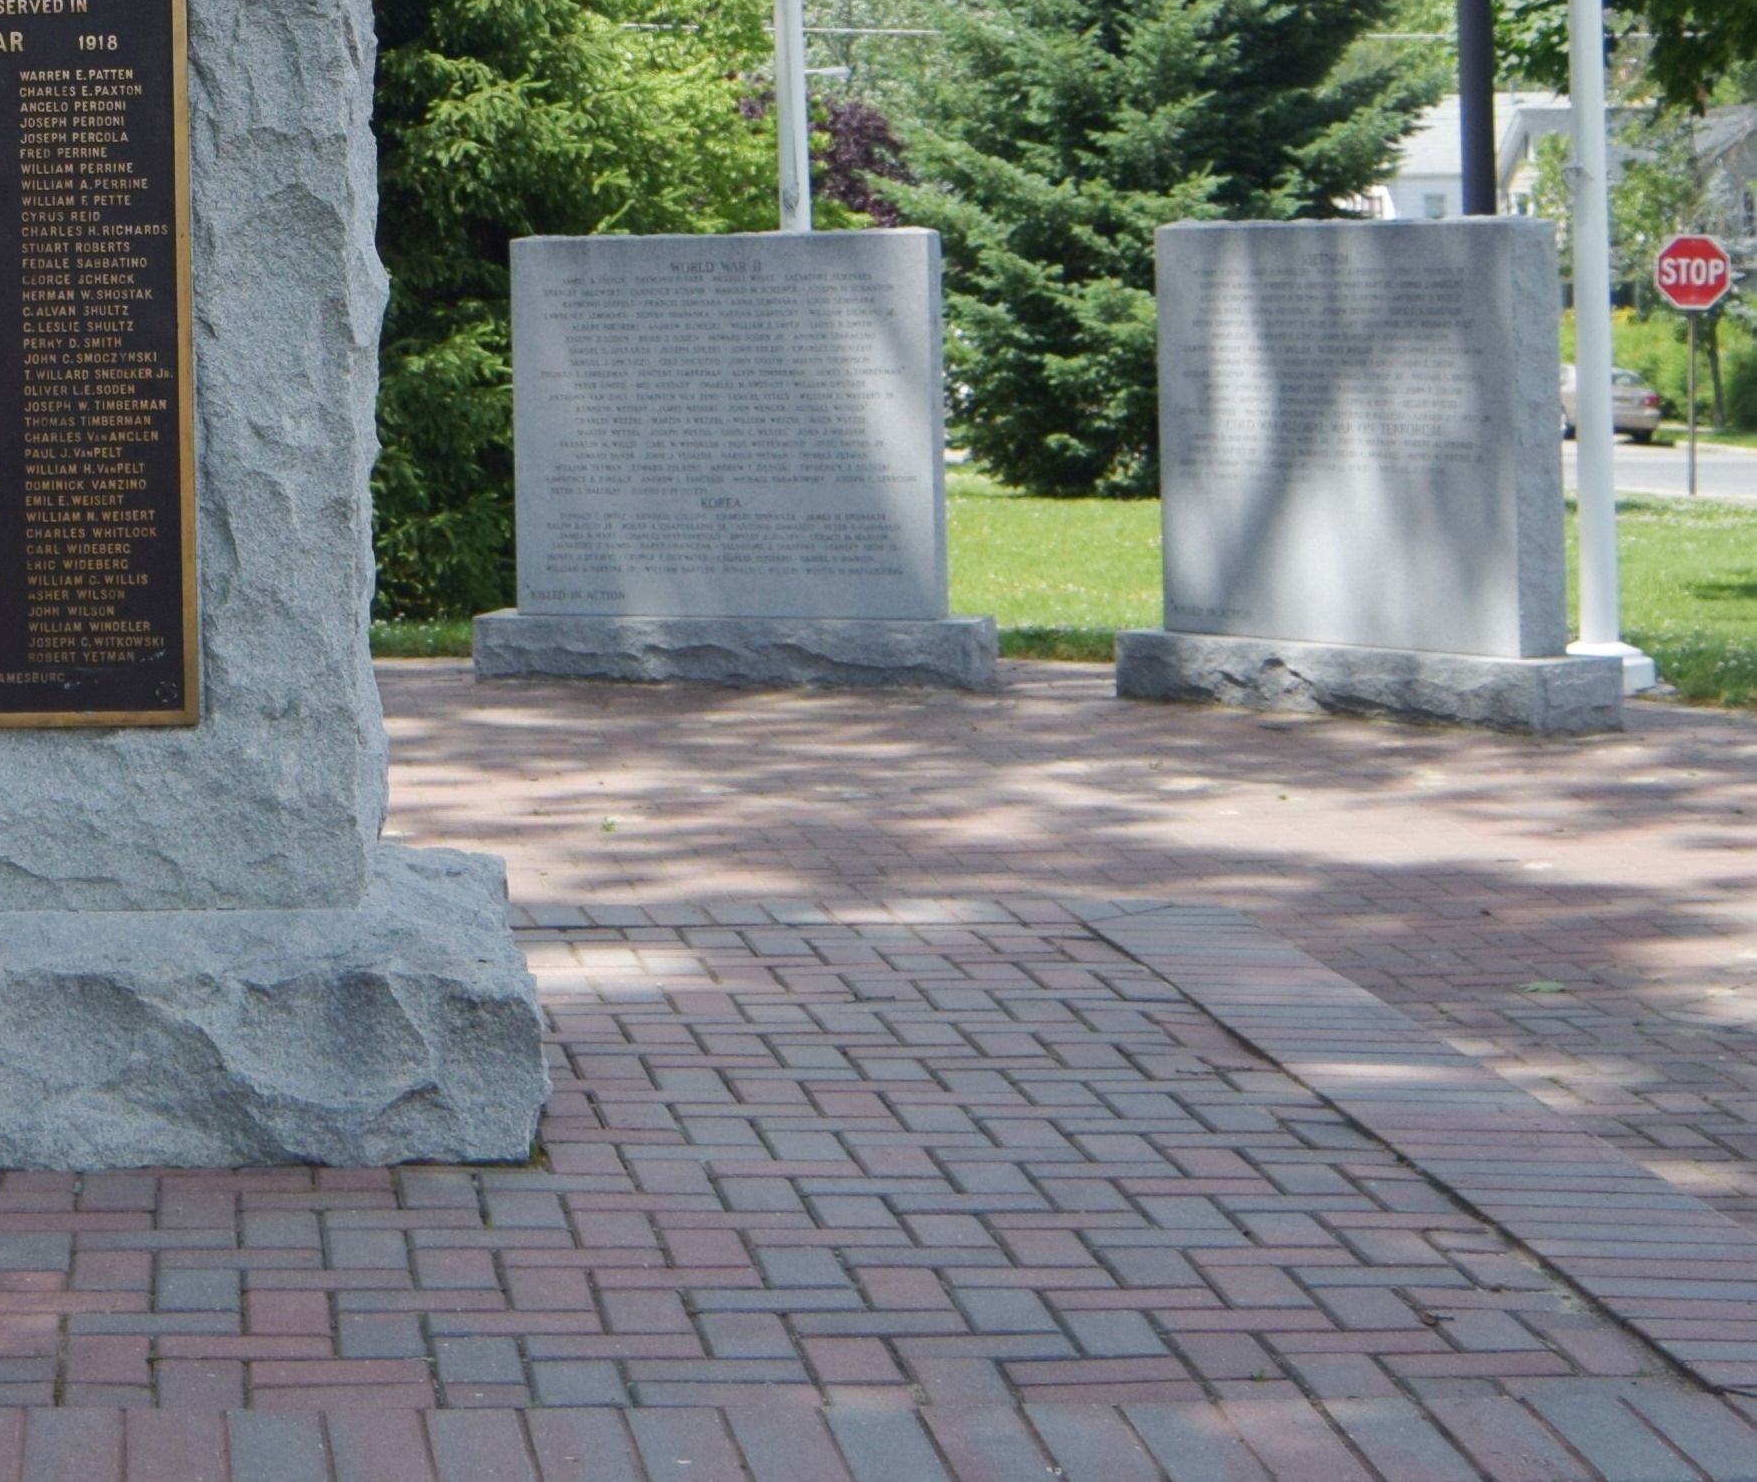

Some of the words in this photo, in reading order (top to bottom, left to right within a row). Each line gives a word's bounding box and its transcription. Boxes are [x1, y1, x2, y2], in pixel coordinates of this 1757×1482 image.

[78, 35, 118, 51] 1918
[74, 100, 126, 112] PERDONI
[20, 116, 67, 128] JOSEPH
[73, 115, 124, 127] PERDONI
[20, 147, 50, 159] FRED
[57, 146, 107, 158] PERRINE
[21, 163, 73, 175] WILLIAM
[80, 162, 133, 174] PERRINE
[21, 211, 64, 223] CYRUS
[71, 210, 100, 222] REID
[22, 242, 68, 254] STUART
[75, 241, 130, 253] ROBERTS
[77, 256, 147, 268] SABBATINO
[670, 261, 715, 273] WORLD
[721, 261, 746, 273] WAR
[753, 260, 762, 272] II
[1660, 258, 1725, 285] STOP
[26, 416, 75, 428] THOMAS
[81, 414, 151, 426] TIMBERMAN
[25, 479, 84, 491] DOMINICK
[92, 477, 146, 489] VANZINO
[701, 497, 742, 509] KOREA
[26, 527, 85, 539] CHARLES
[93, 525, 156, 537] WHITLOCK
[77, 588, 125, 600] WILSON
[587, 589, 626, 601] ACTION
[29, 605, 60, 617] JOHN
[68, 604, 115, 616] WILSON
[29, 621, 82, 633] WILLIAM
[90, 619, 150, 631] WINDELER
[28, 650, 76, 662] ROBERT
[83, 648, 135, 660] YETMAN
